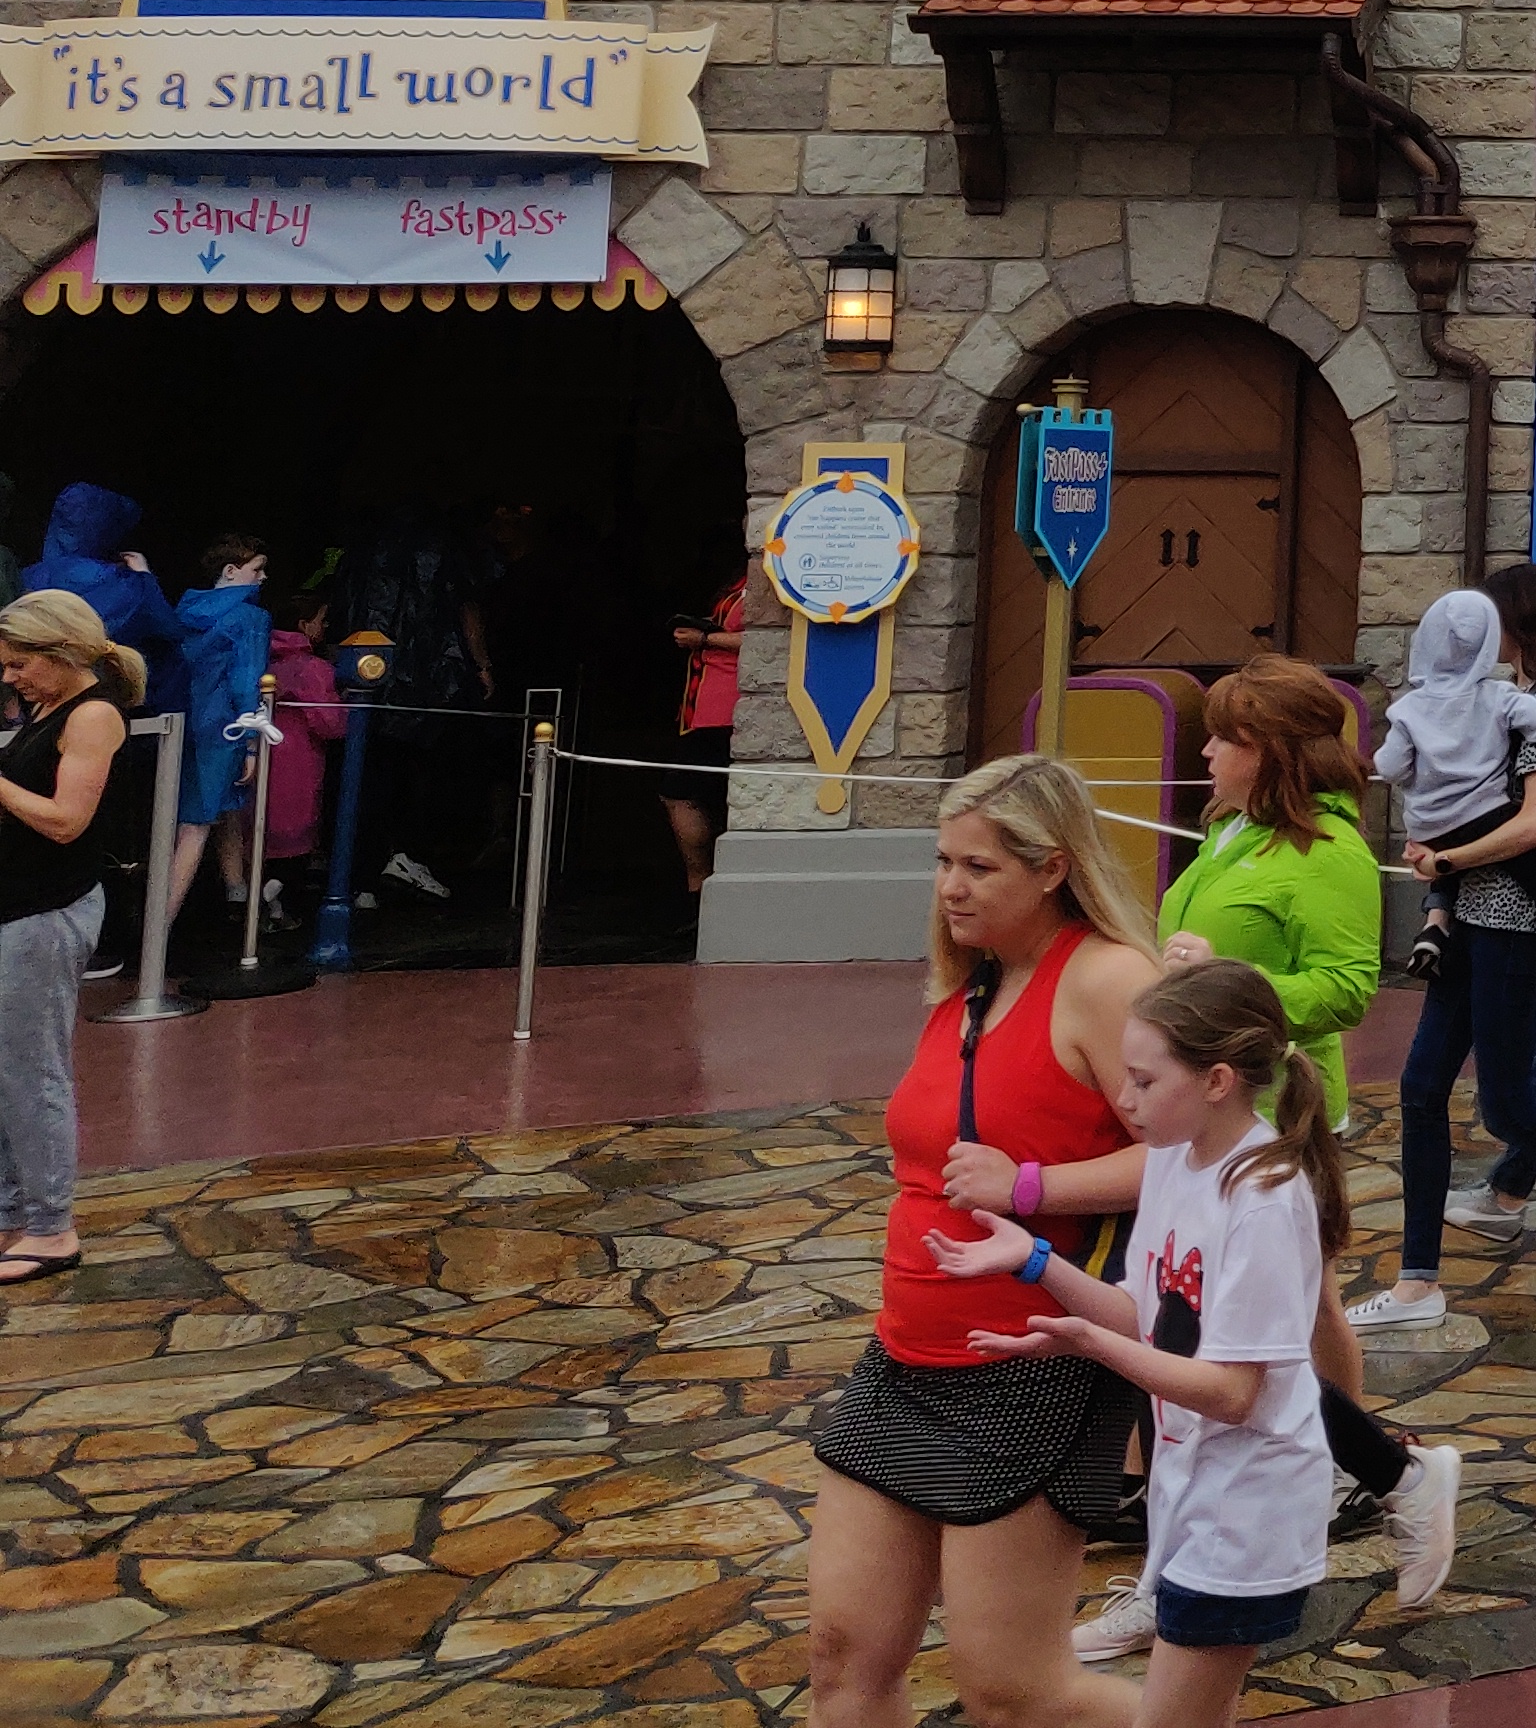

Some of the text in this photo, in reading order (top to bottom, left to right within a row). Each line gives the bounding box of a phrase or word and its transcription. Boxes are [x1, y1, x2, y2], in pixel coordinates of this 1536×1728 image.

[159, 72, 187, 110] a
[207, 52, 378, 114] small
[148, 197, 568, 248] stand-by fastpass+
